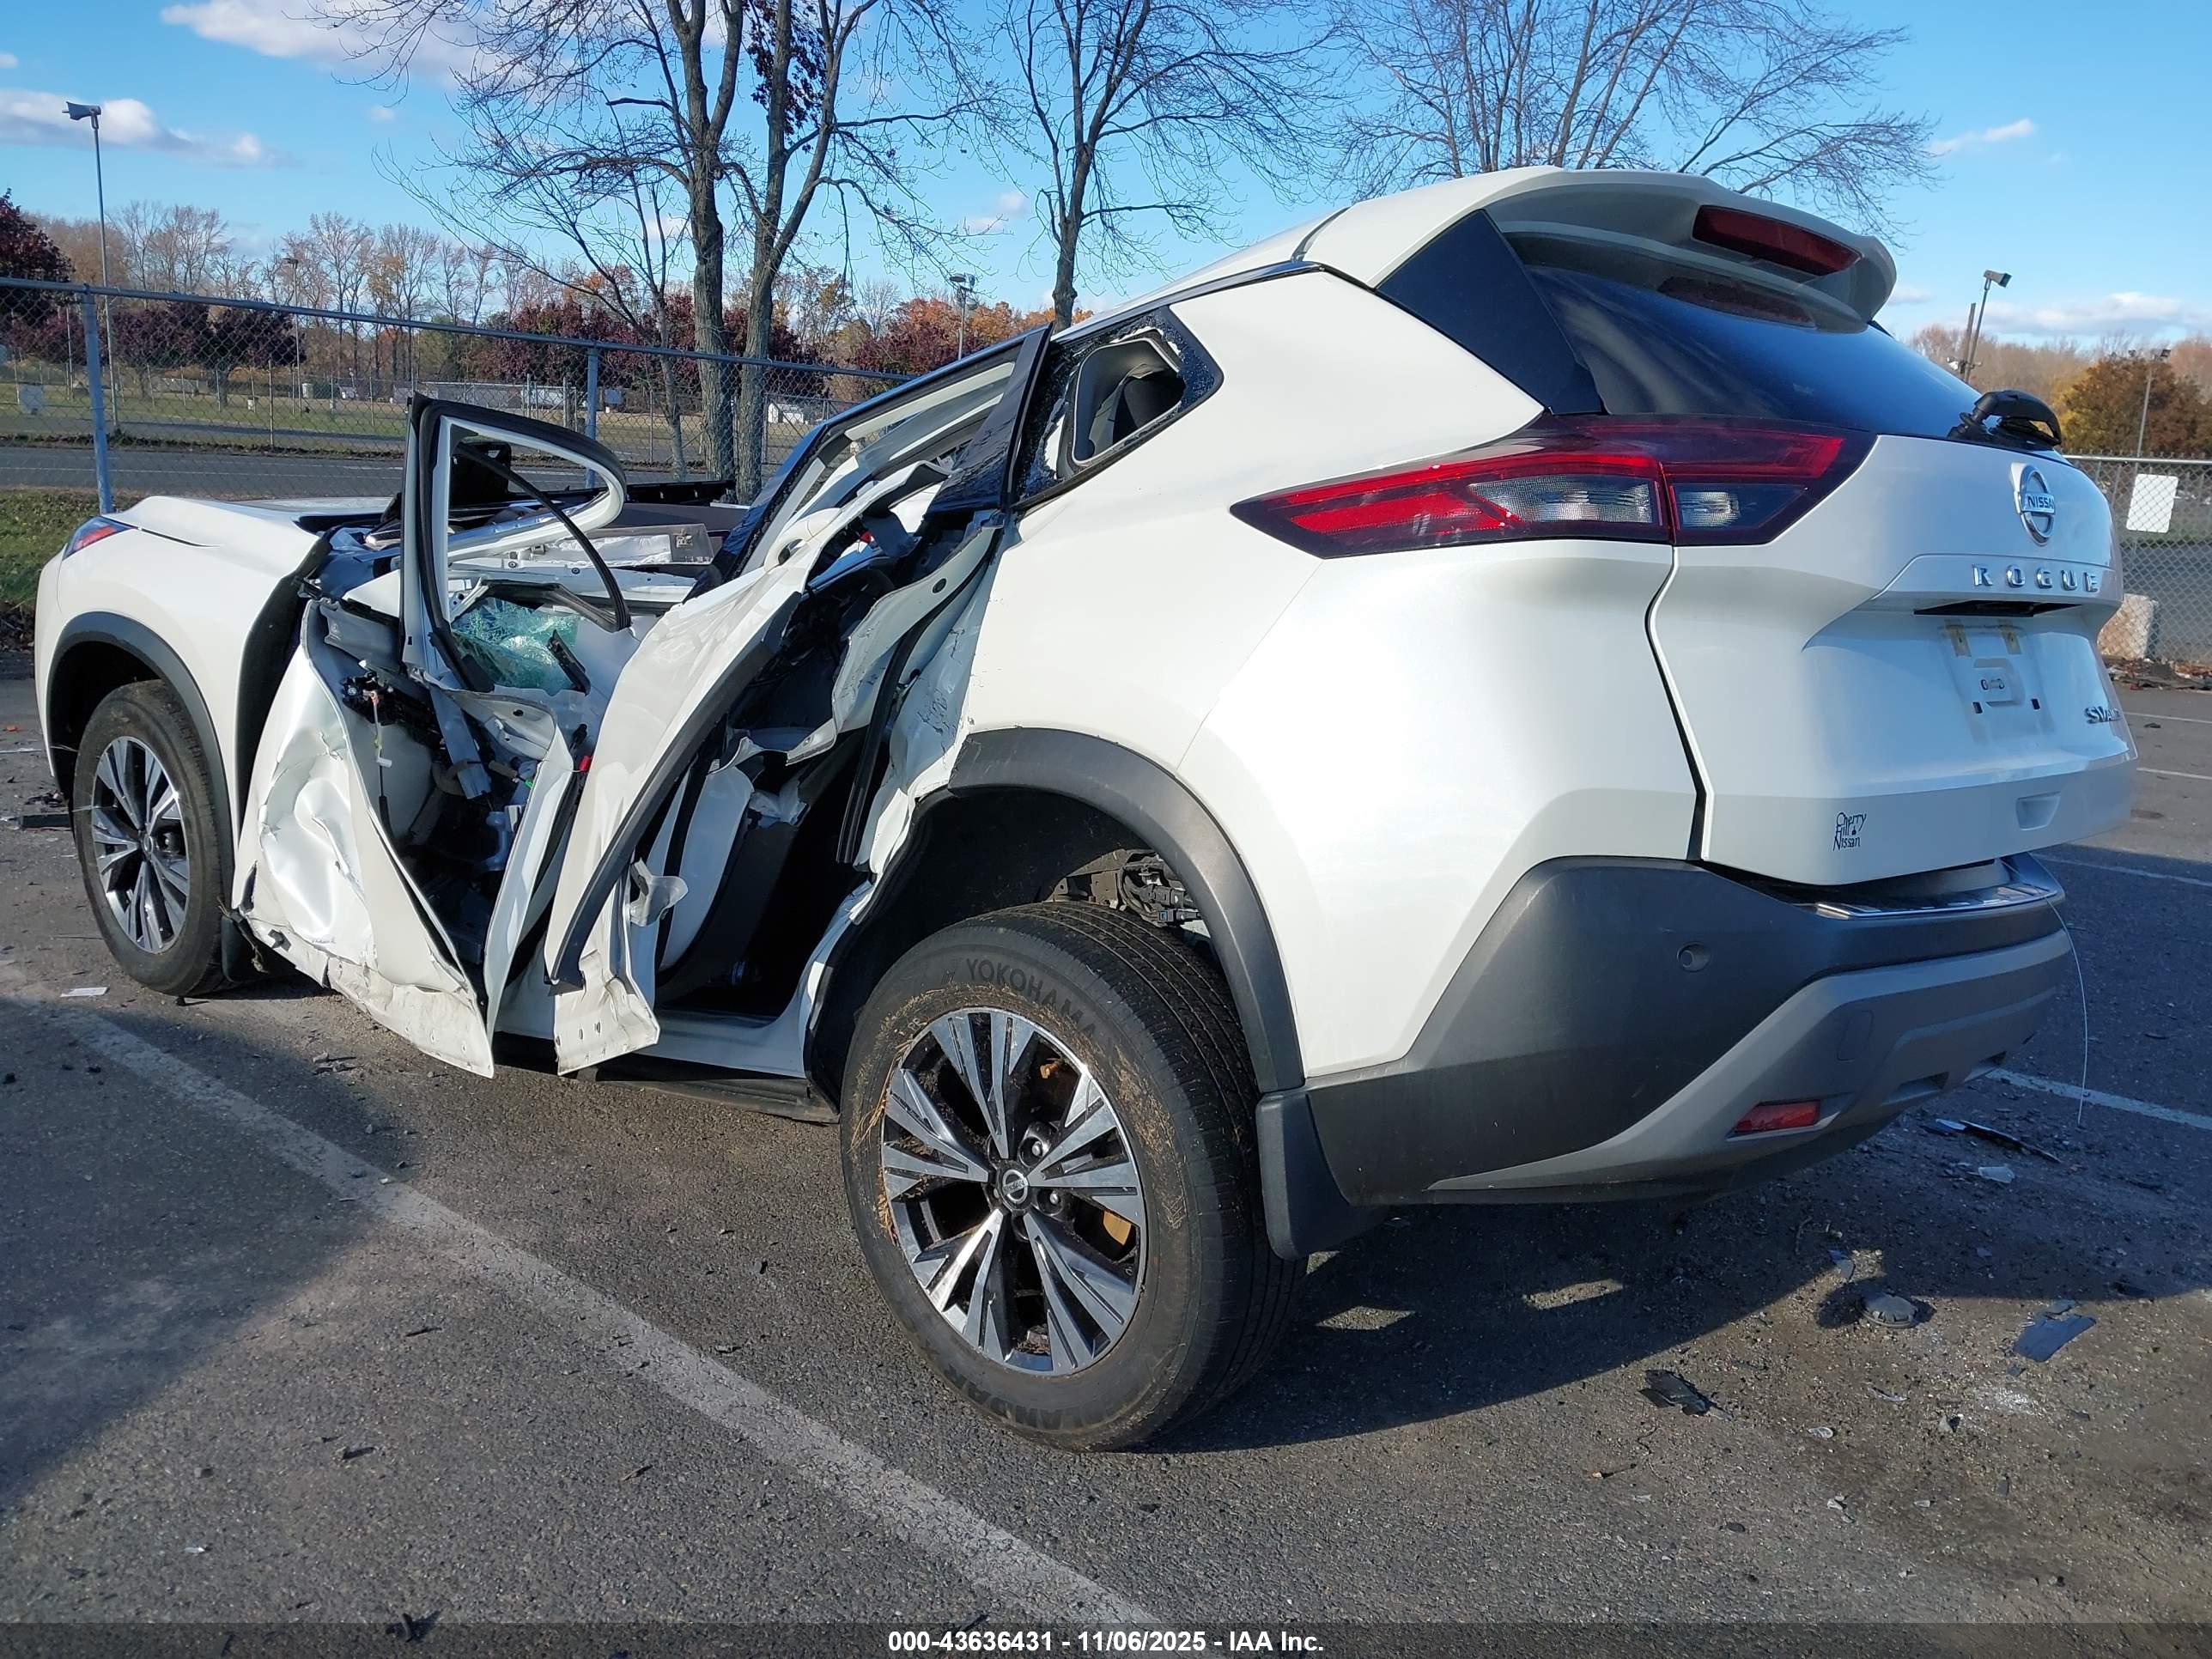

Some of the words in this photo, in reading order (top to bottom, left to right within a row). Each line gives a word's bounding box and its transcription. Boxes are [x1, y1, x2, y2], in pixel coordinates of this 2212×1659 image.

[2027, 495, 2055, 508] NISSA
[1972, 563, 2100, 592] ROGUE
[1836, 811, 1867, 831] Cherry
[1832, 836, 1861, 851] Nissan
[966, 957, 1097, 1042] YOKOHAMA
